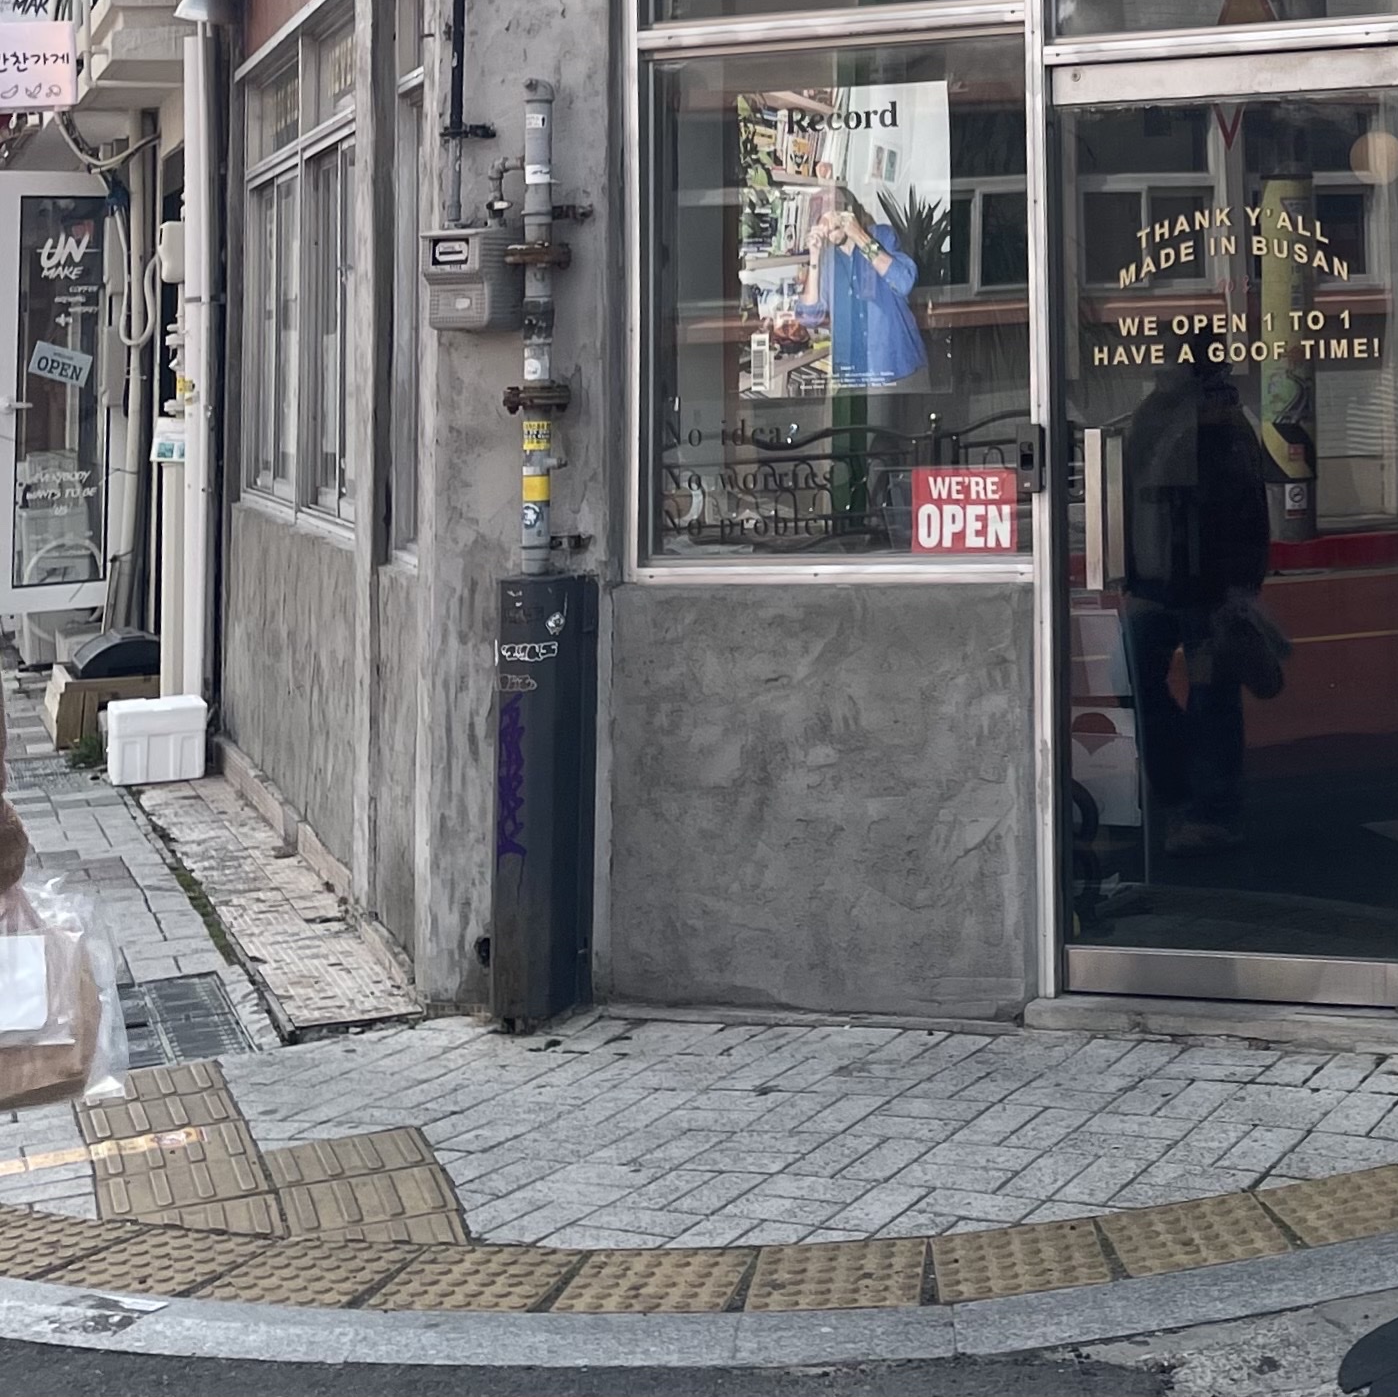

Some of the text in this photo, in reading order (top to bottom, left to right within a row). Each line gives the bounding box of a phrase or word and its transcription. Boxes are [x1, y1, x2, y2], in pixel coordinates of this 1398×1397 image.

[786, 100, 899, 135] Record
[1137, 207, 1330, 249] THANK Y'ALL
[41, 232, 90, 269] UN
[1119, 236, 1349, 290] MADE IN BUSAN
[41, 266, 83, 280] MAKE
[1118, 310, 1351, 336] WE OPEN 1 TO 1
[1093, 338, 1380, 366] HAVE A GOOF TIME!
[37, 356, 83, 381] OPEN
[928, 476, 1000, 501] WE'RE
[917, 504, 1013, 549] OPEN
